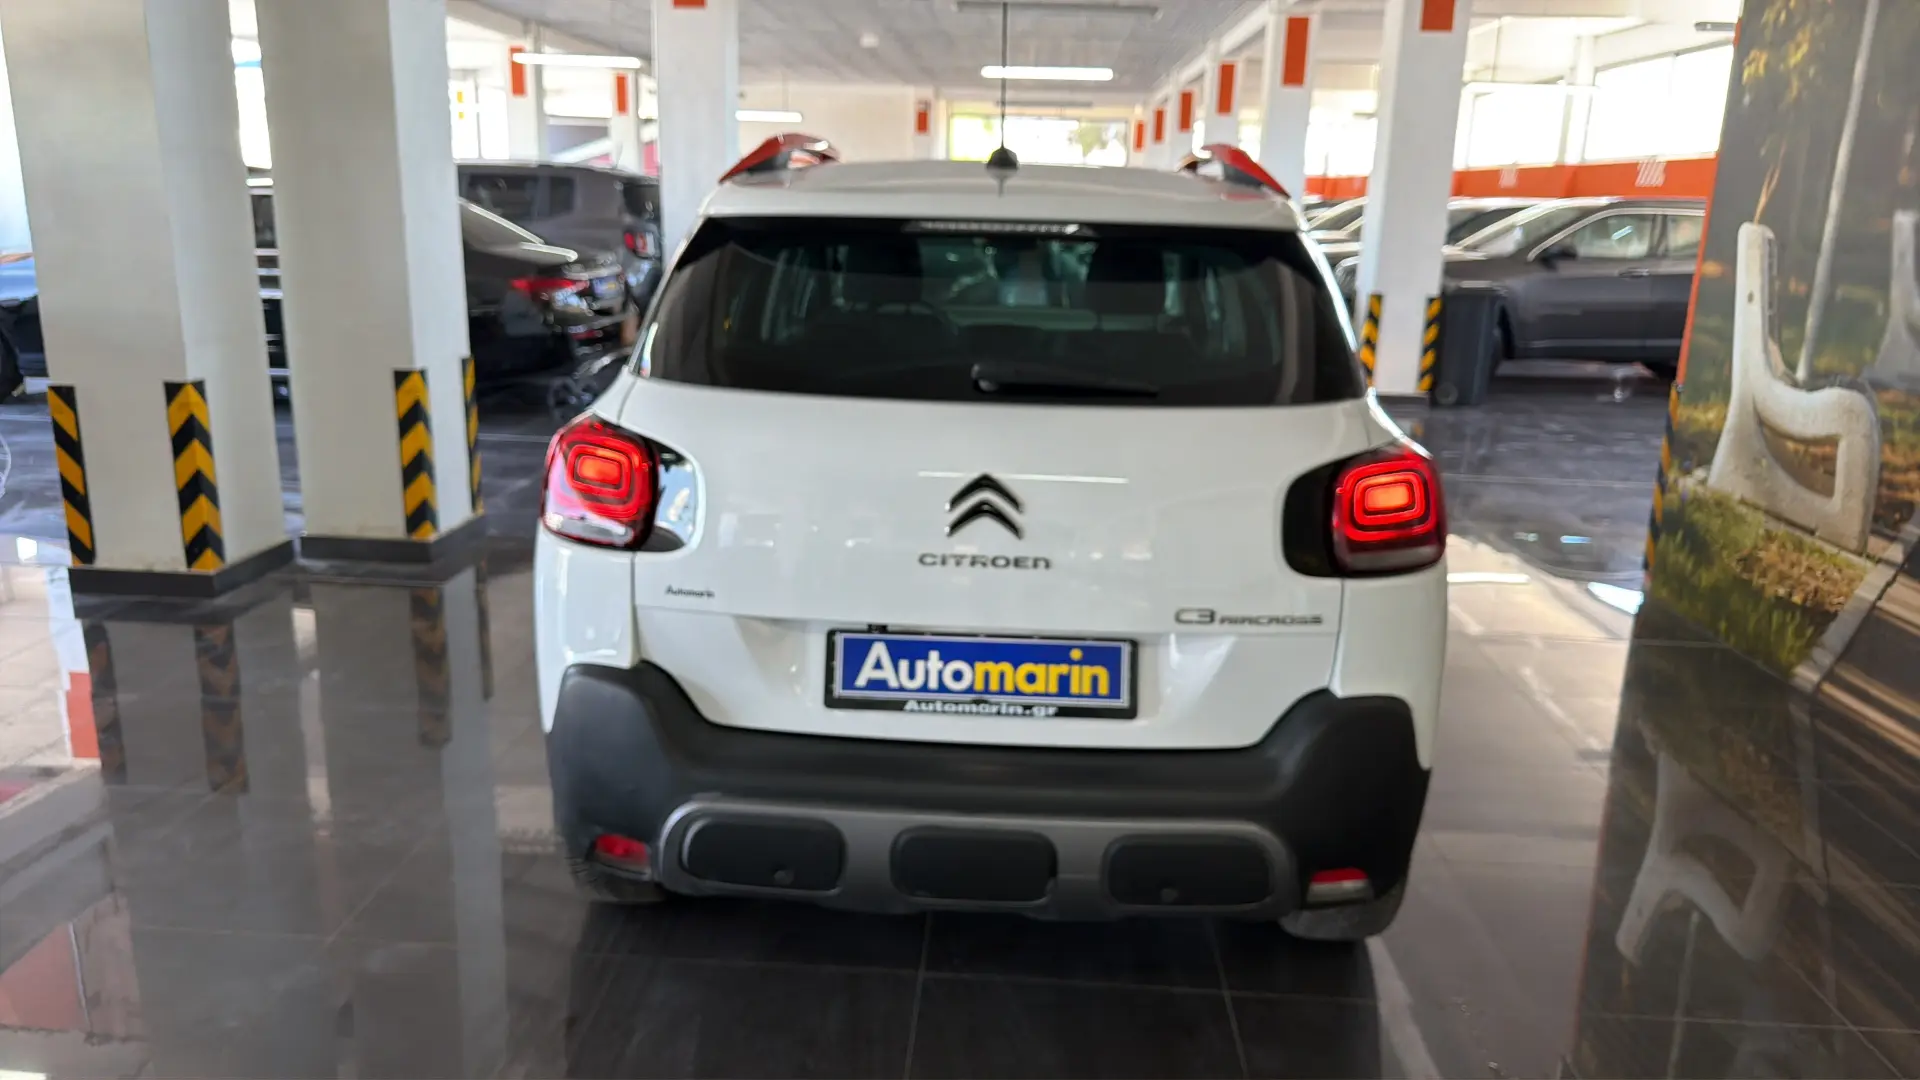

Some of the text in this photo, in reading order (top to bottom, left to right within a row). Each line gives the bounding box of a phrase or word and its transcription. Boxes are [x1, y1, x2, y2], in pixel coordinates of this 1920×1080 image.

[1174, 607, 1216, 625] C3
[854, 640, 1110, 696] Automarin
[903, 699, 1059, 718] Automarin.gr
